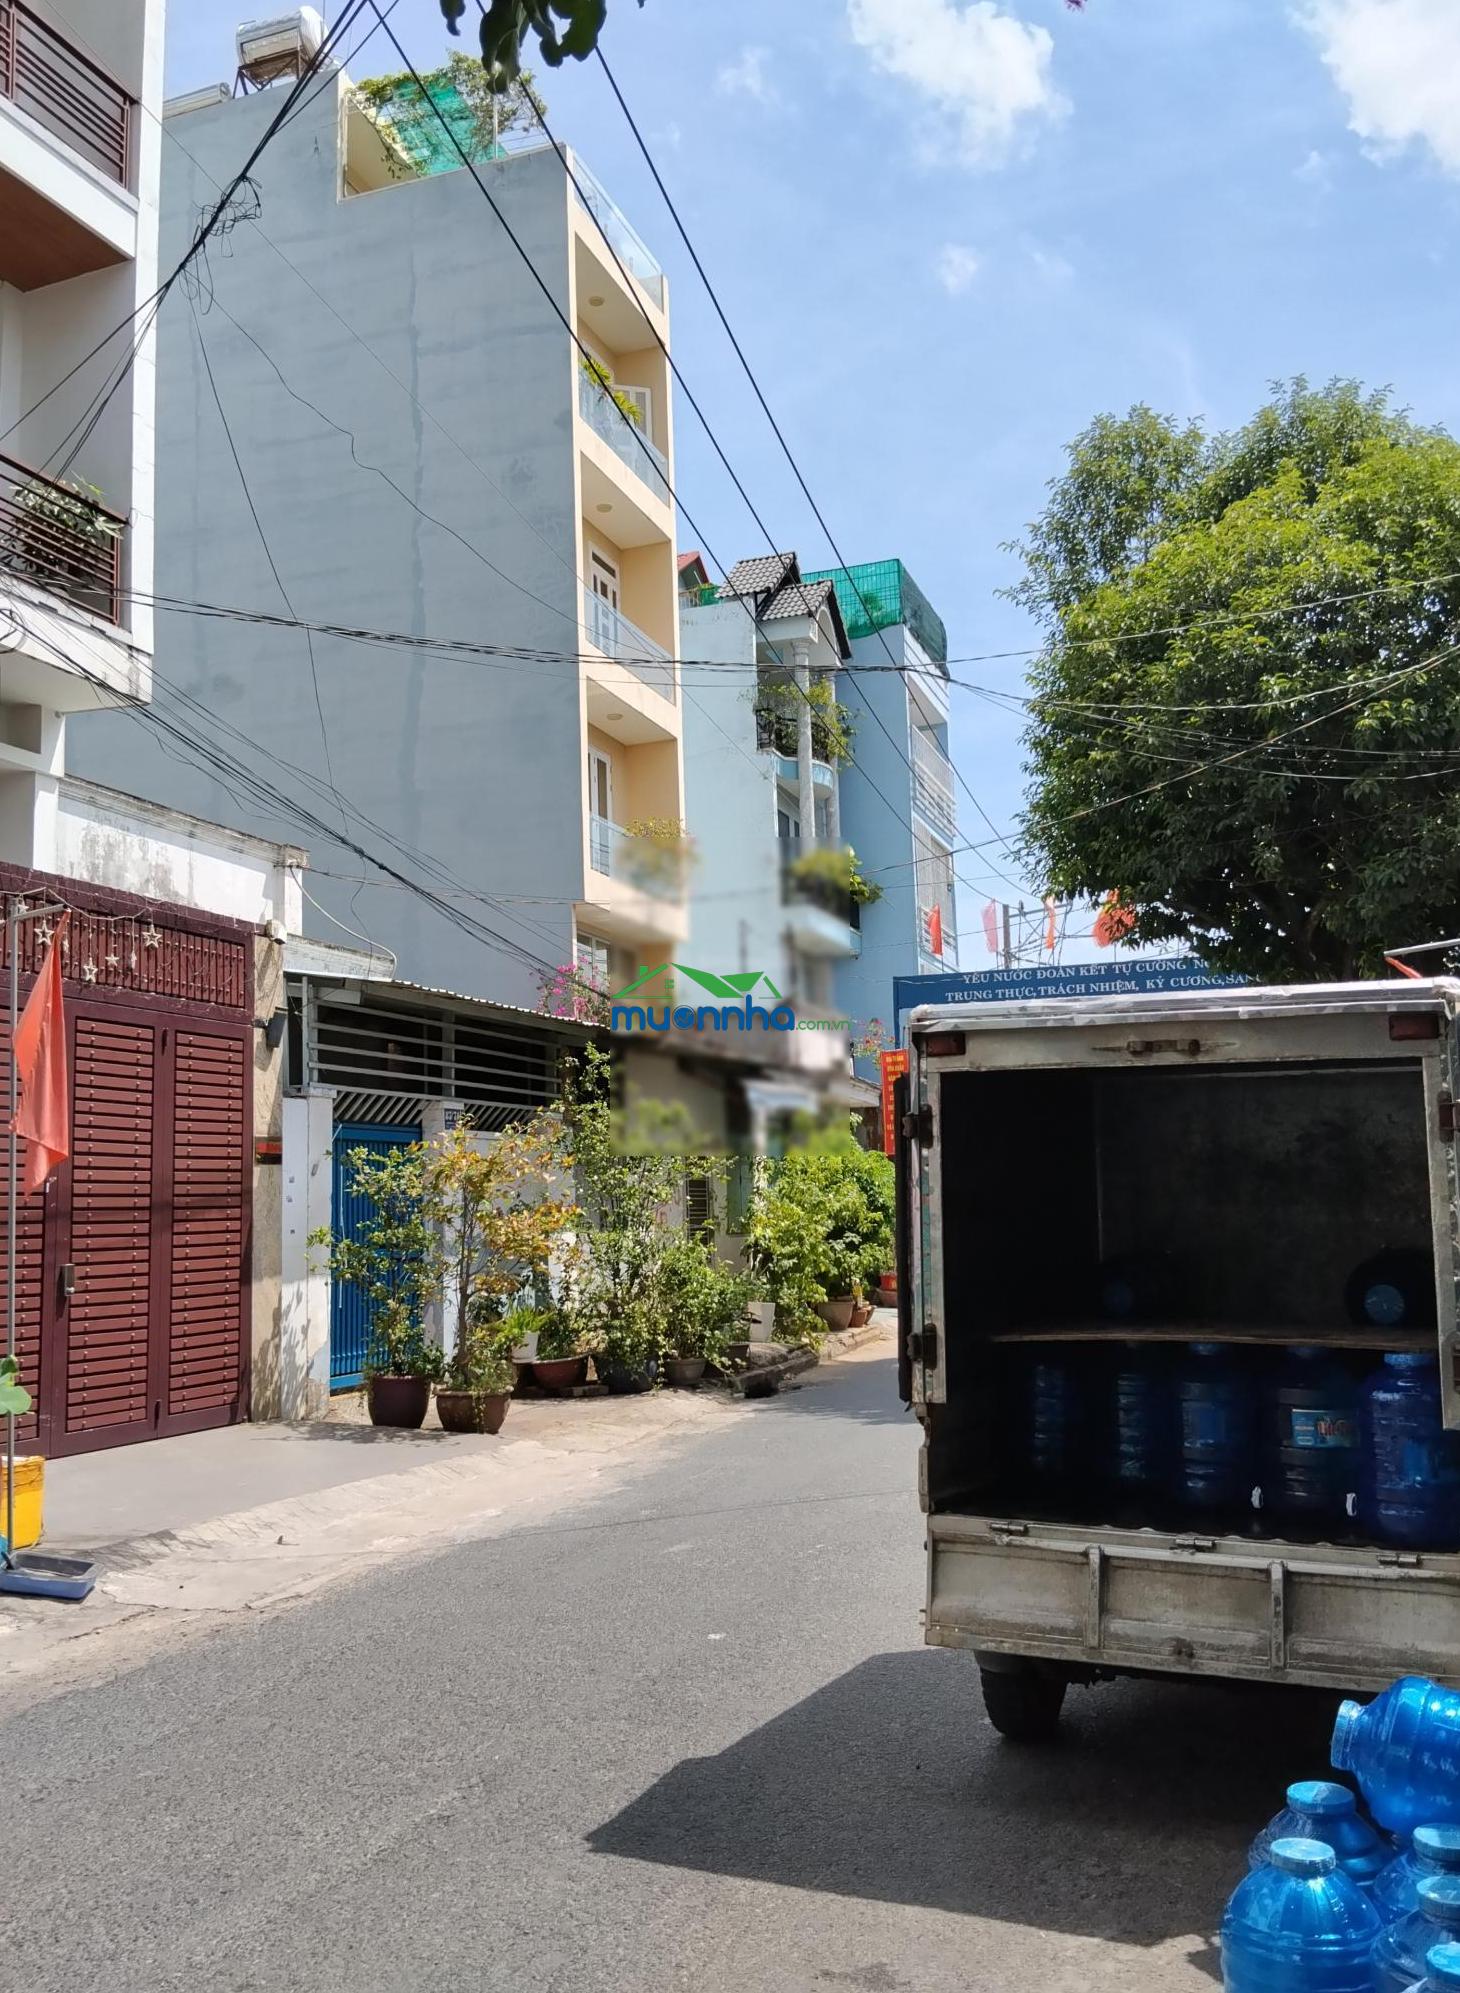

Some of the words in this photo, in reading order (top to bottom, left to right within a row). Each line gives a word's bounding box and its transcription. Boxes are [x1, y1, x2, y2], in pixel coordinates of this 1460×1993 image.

[963, 972, 990, 984] YÊU
[993, 968, 1032, 982] NƯỚC
[1080, 963, 1107, 976] KẾT
[1112, 963, 1132, 976] TỰ
[1135, 959, 1186, 973] CƯỜNG
[945, 990, 993, 1002] TRUNG
[1038, 983, 1085, 996] TRÁCH
